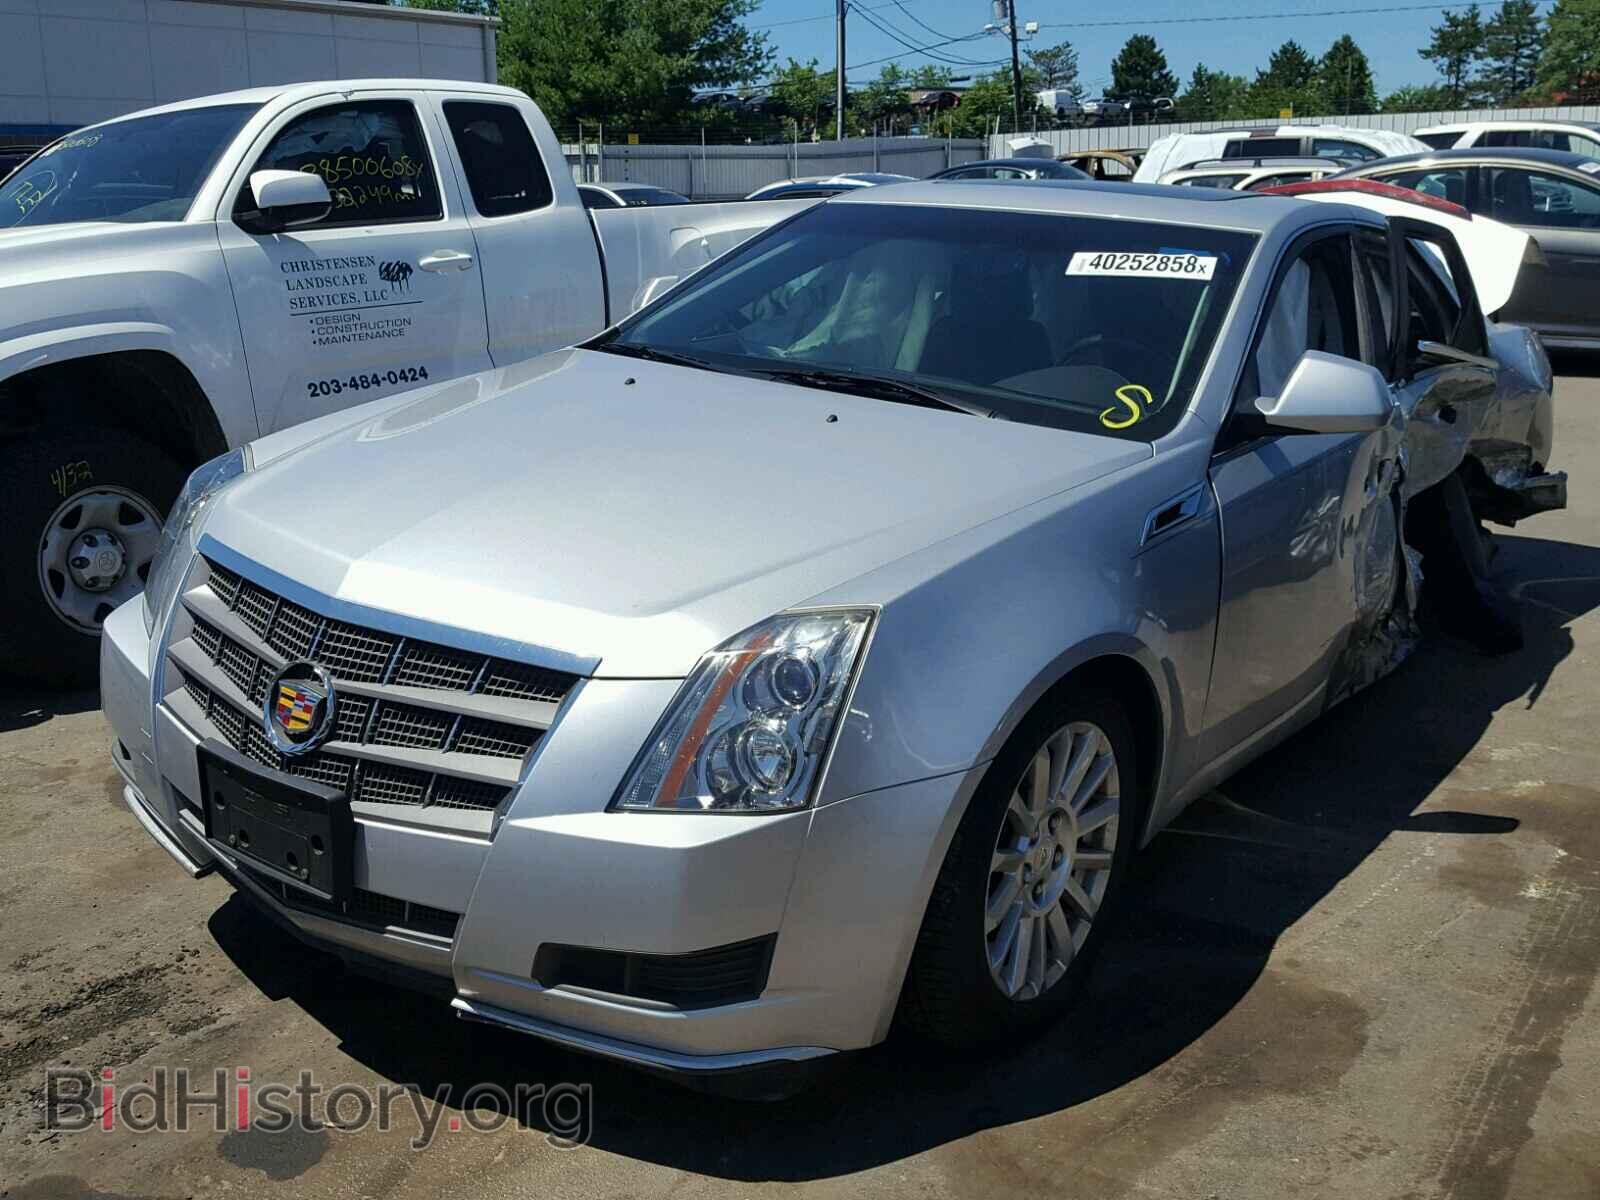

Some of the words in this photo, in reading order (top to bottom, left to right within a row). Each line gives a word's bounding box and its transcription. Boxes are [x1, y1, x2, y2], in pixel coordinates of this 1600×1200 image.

[280, 255, 376, 273] CHRISTENSEN
[286, 272, 368, 291] LANDSCAPE
[289, 292, 361, 310] SERVICES,
[364, 289, 388, 302] LLC
[315, 312, 361, 326] DESIGN
[317, 317, 412, 336] CONSTRUCTION
[318, 327, 405, 346] MAINTENANCE
[307, 366, 429, 398] 203-484-0424
[1099, 384, 1153, 429] S
